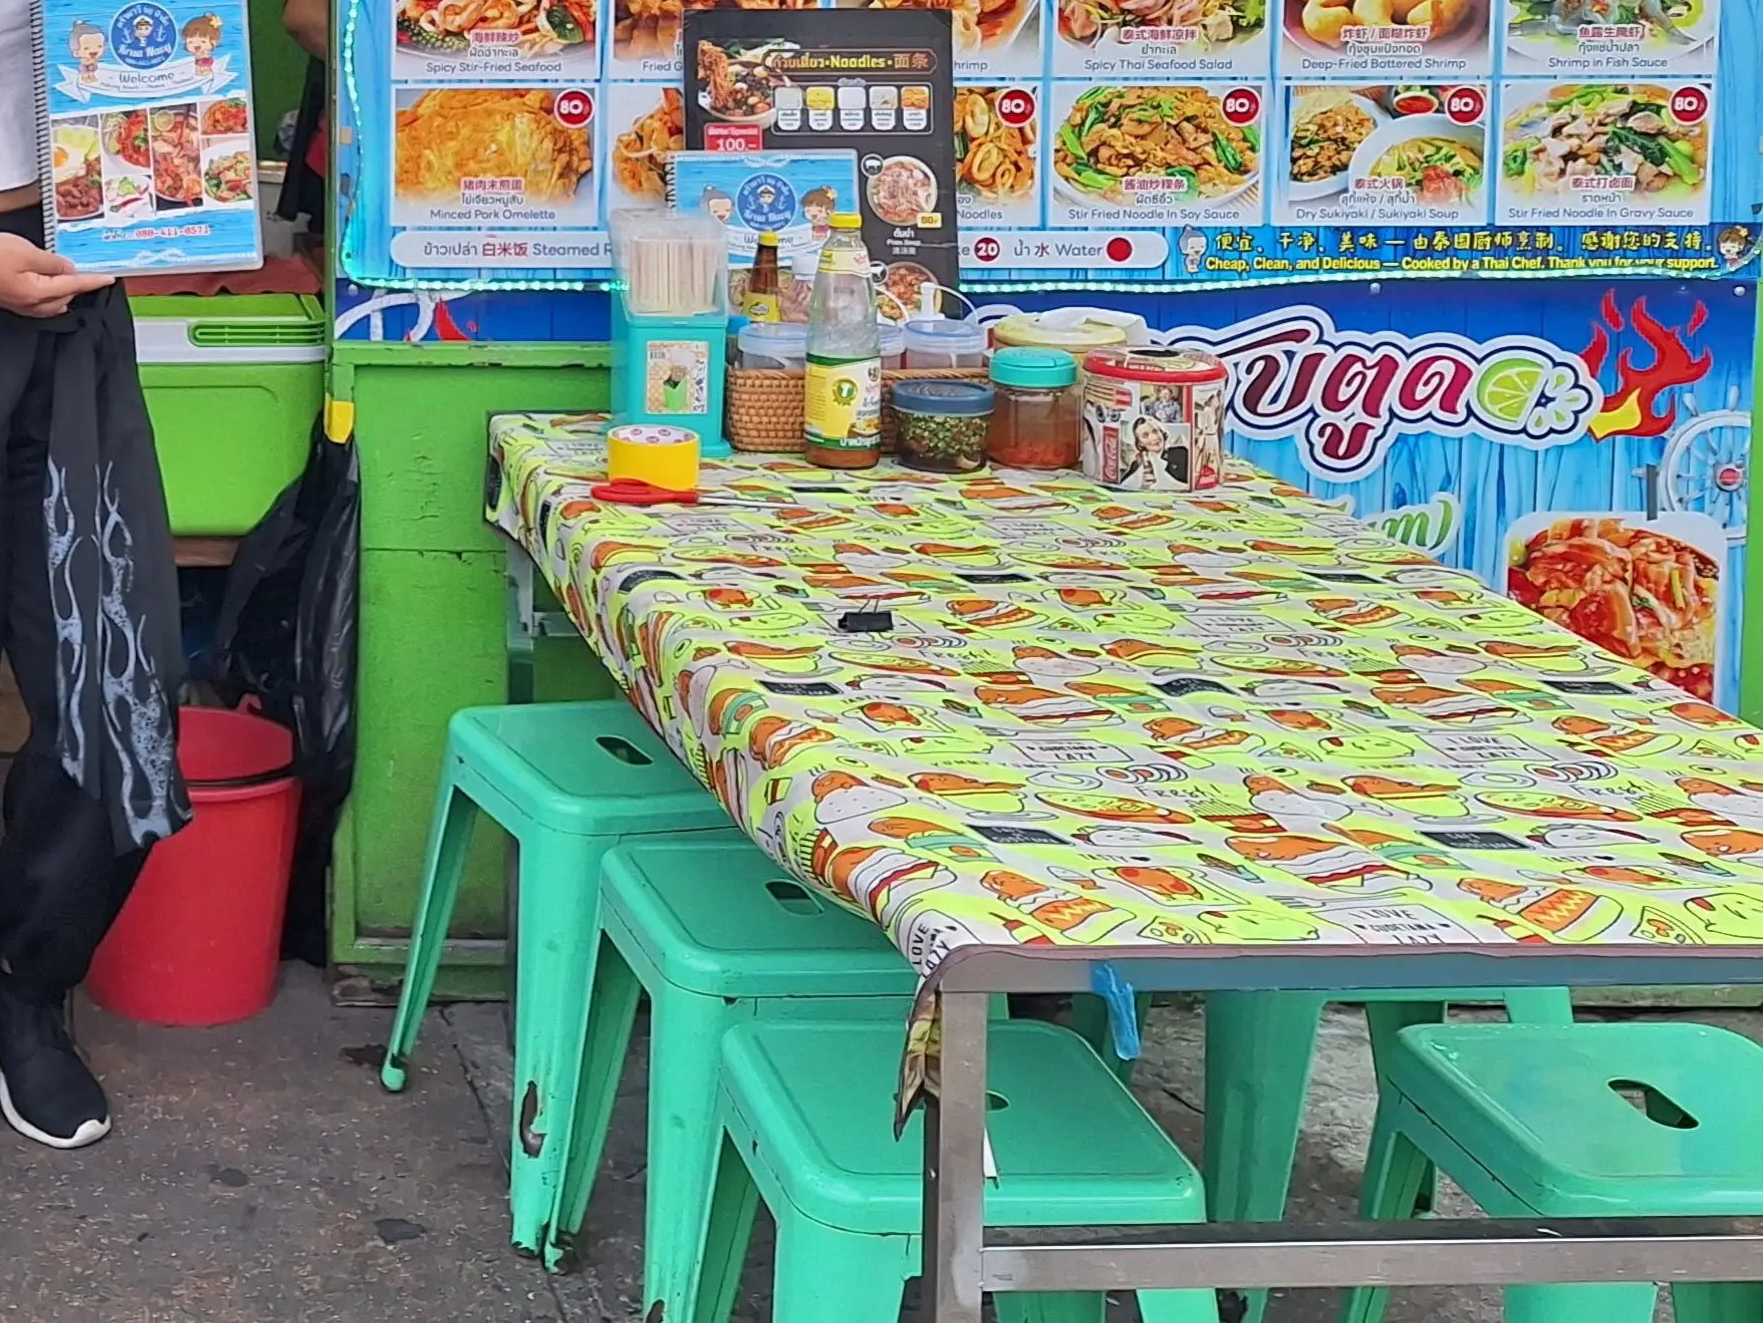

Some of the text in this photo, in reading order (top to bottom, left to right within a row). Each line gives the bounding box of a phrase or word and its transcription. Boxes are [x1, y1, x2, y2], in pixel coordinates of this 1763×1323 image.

[831, 55, 885, 68] Noodles
[1085, 59, 1232, 72] Spicy Thai Seafood Salad
[1549, 57, 1668, 70] Shrimp in Fish Sauce
[119, 72, 174, 84] Welcome
[482, 242, 528, 257] 白米饭
[533, 243, 599, 256] Steamed
[977, 243, 997, 255] 20
[1034, 244, 1050, 257] 水
[1055, 244, 1102, 257] Water
[1206, 258, 1249, 271] Cheap,
[1253, 257, 1293, 271] Clean,
[1296, 258, 1319, 269] and
[1323, 257, 1380, 269] Delicious
[1402, 257, 1450, 269] Cooked
[1453, 258, 1469, 271] by
[1482, 257, 1509, 268] Thai
[1512, 257, 1544, 269] Chef.
[1548, 257, 1585, 268] Thank
[1666, 257, 1718, 270] support.
